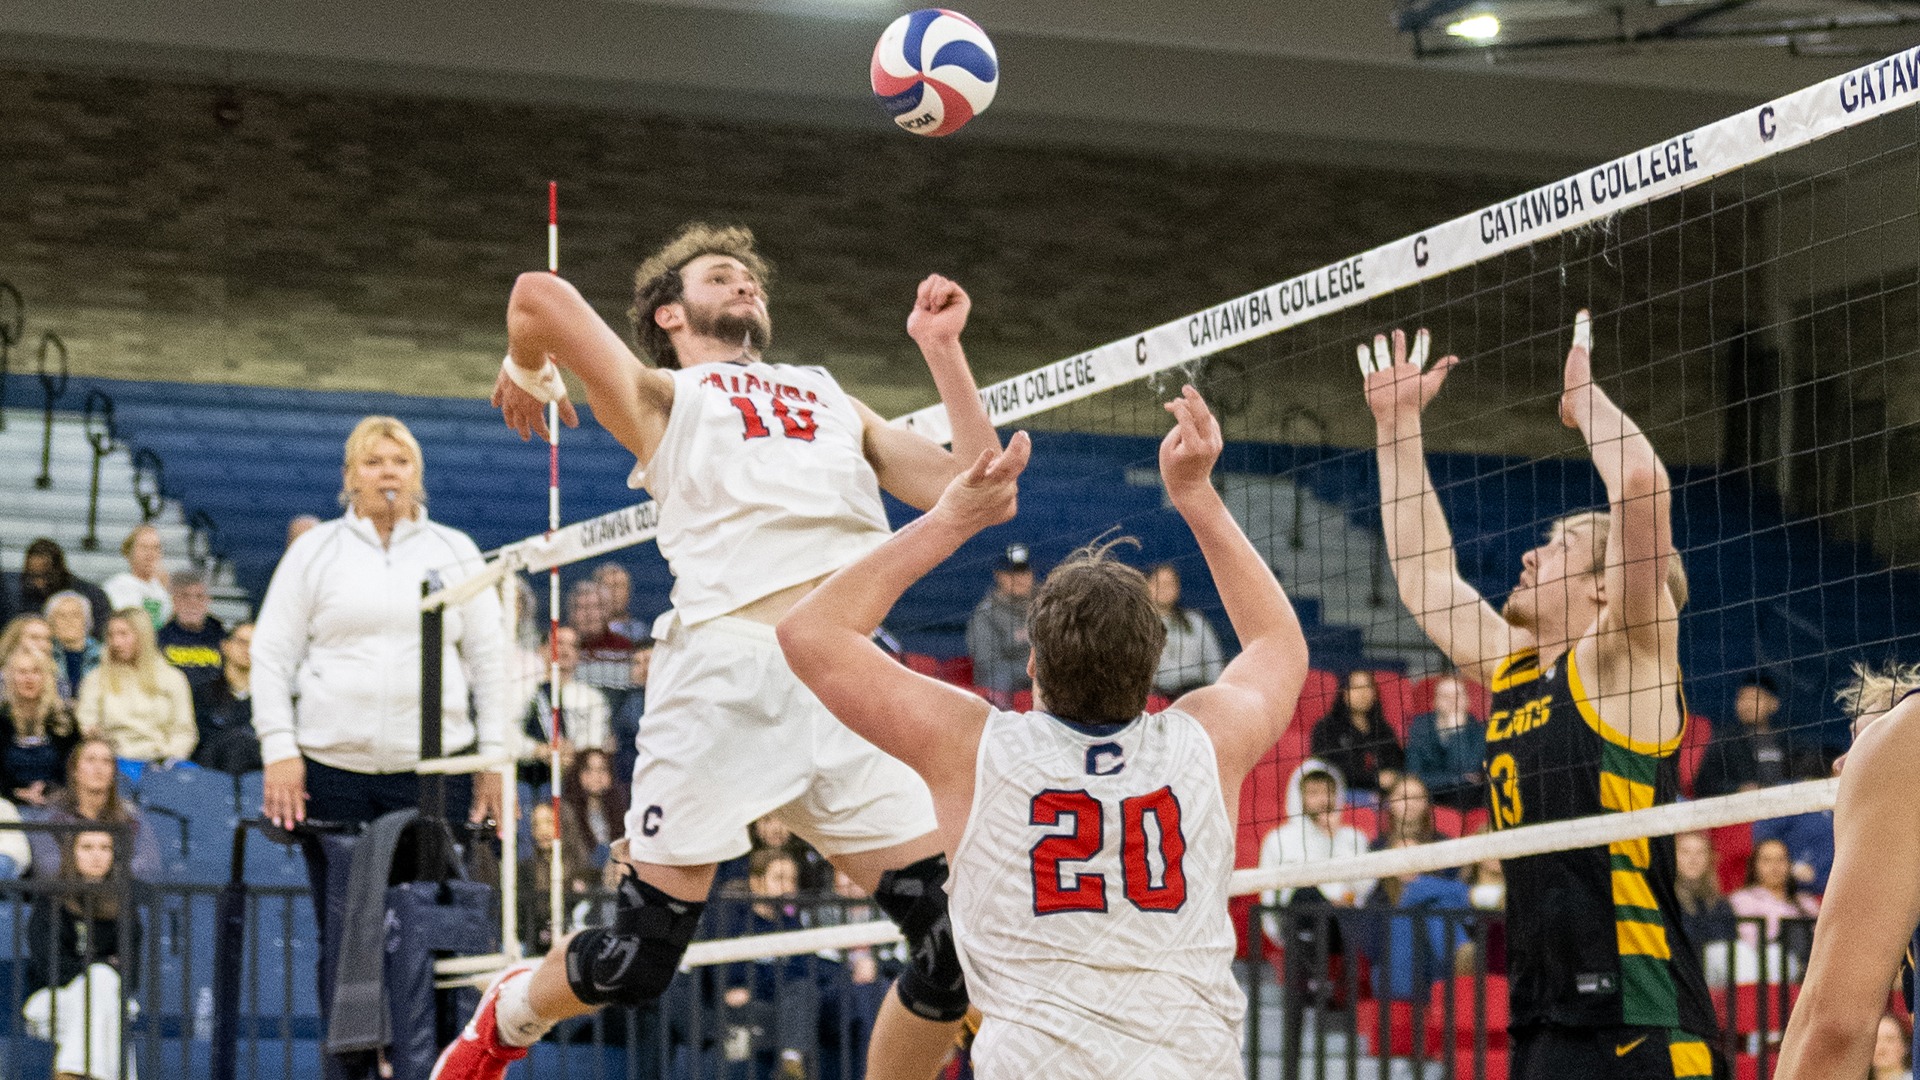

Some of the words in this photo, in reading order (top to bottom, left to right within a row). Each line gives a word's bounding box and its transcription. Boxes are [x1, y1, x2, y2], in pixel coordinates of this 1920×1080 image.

[1759, 106, 1776, 142] C
[1480, 178, 1584, 244] CATAWBA
[1590, 134, 1698, 204] COLLEGE
[1414, 236, 1429, 267] C
[1189, 293, 1273, 347] CATAWBA
[1279, 257, 1365, 316] COLLEGE
[1136, 338, 1147, 365] C
[1024, 354, 1096, 405] COLLEGE
[1085, 741, 1126, 776] C
[642, 804, 664, 838] C
[1029, 785, 1187, 917] 20
